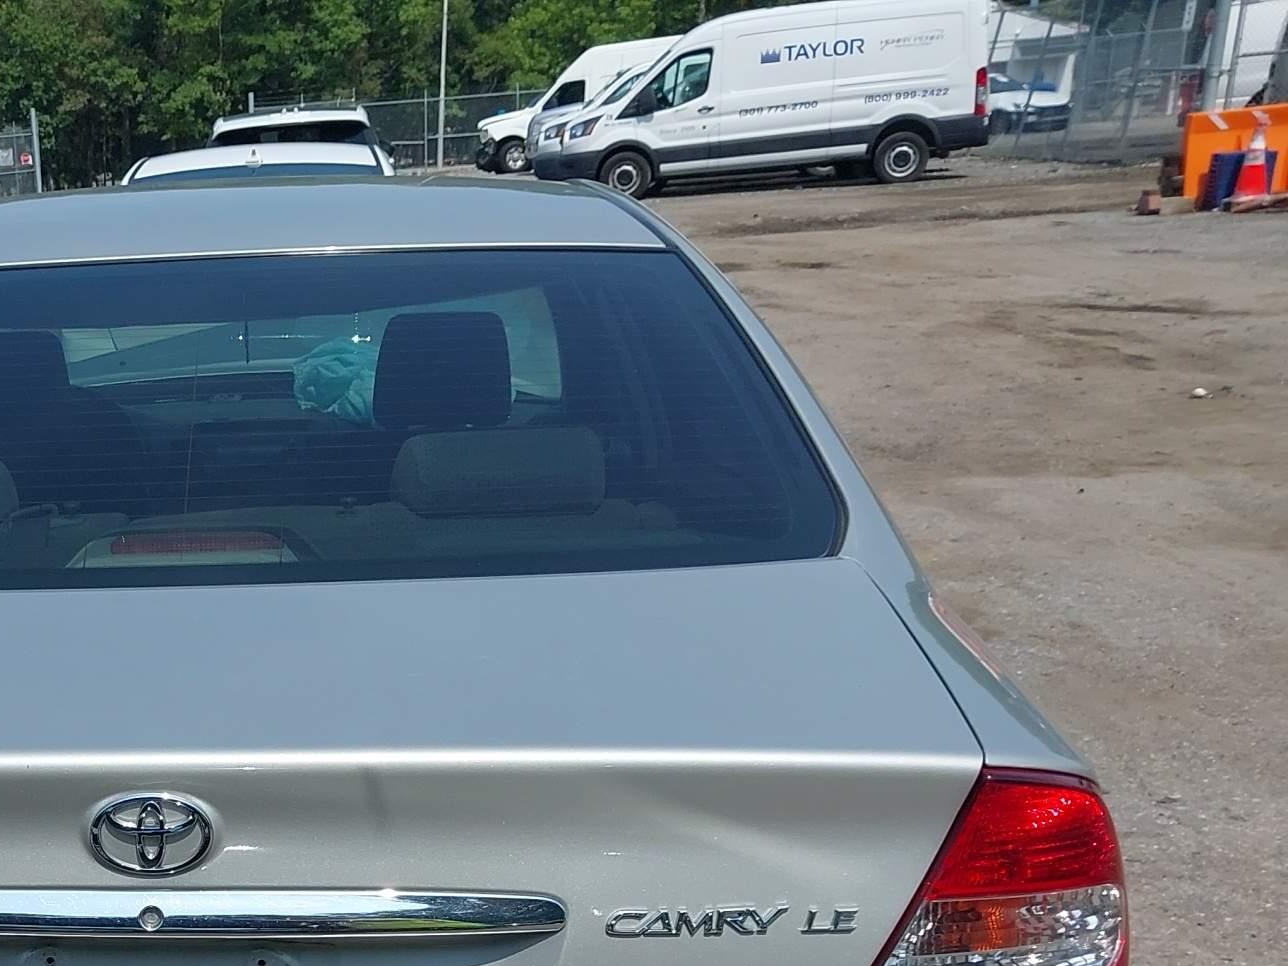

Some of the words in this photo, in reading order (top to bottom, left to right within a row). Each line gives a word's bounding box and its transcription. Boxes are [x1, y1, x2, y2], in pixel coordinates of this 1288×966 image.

[784, 38, 865, 62] TAYLOR
[604, 901, 790, 938] CAMRY
[799, 904, 860, 936] LE
